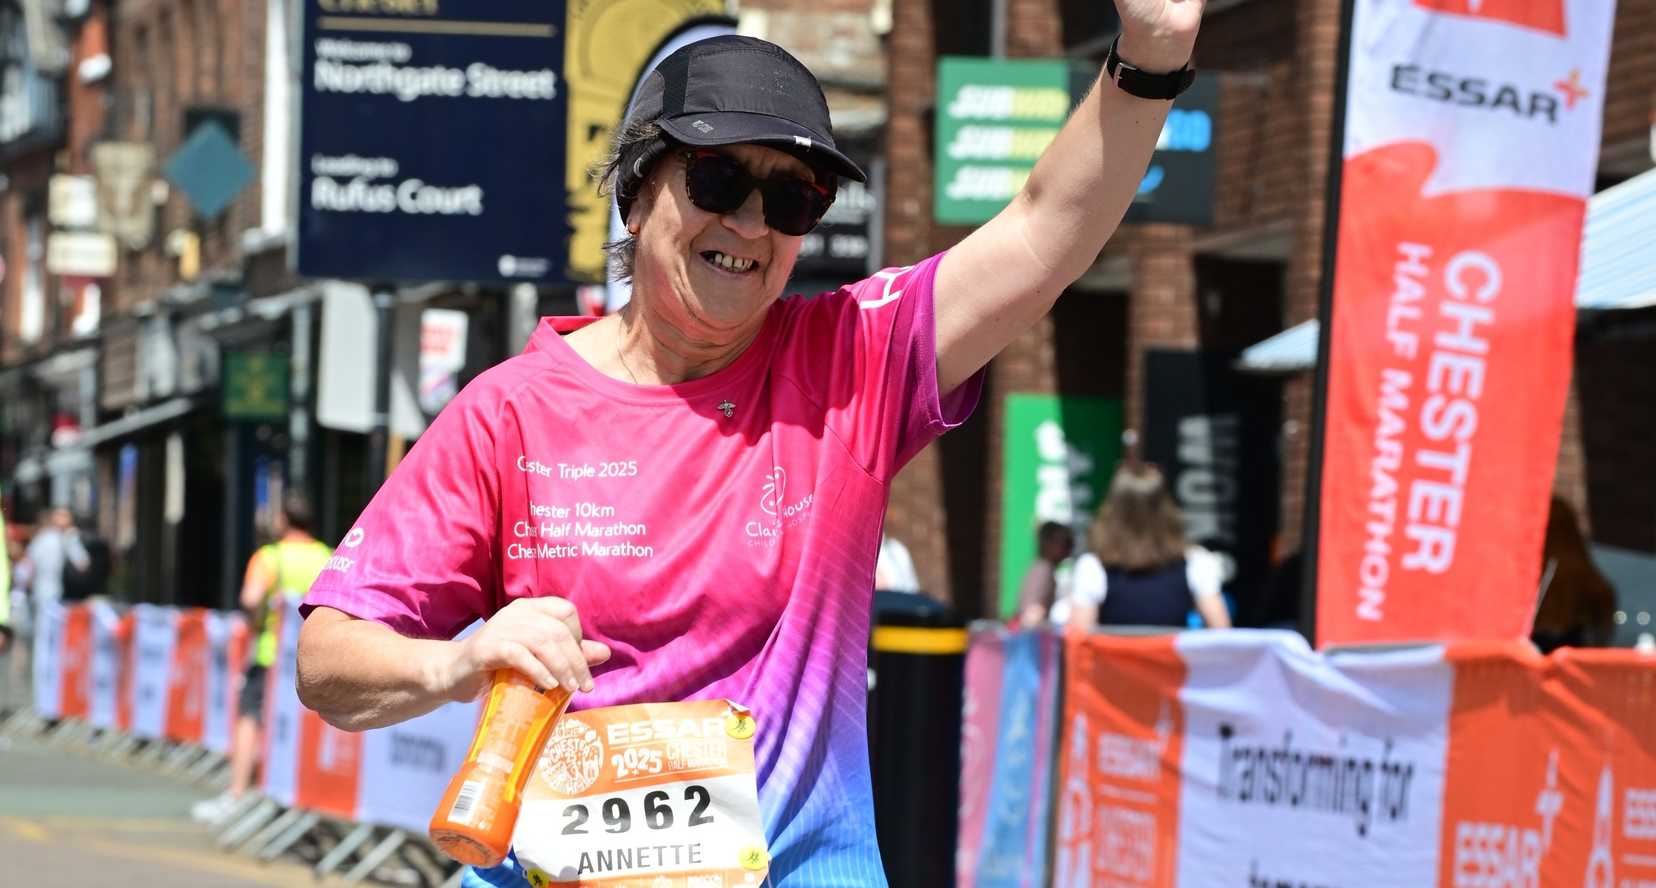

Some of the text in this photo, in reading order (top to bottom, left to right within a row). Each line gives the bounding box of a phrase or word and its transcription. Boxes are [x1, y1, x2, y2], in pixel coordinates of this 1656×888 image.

[314, 60, 556, 102] Northgate Street
[1390, 64, 1560, 124] ESSAR
[311, 176, 484, 216] Rufus Court
[1402, 251, 1502, 574] CHESTER
[1356, 241, 1433, 621] HALF MARATHON
[558, 463, 596, 481] Triple
[598, 460, 638, 478] 2025
[530, 500, 615, 519] hester 10km
[540, 521, 571, 538] Half
[575, 521, 646, 538] Marathon
[537, 542, 578, 560] Metric
[582, 540, 654, 557] Marathon
[607, 717, 724, 745] ESSAR
[611, 747, 663, 778] 2025
[1217, 723, 1415, 838] Transforming for
[561, 785, 715, 836] 2962
[577, 843, 702, 876] ANNETTE
